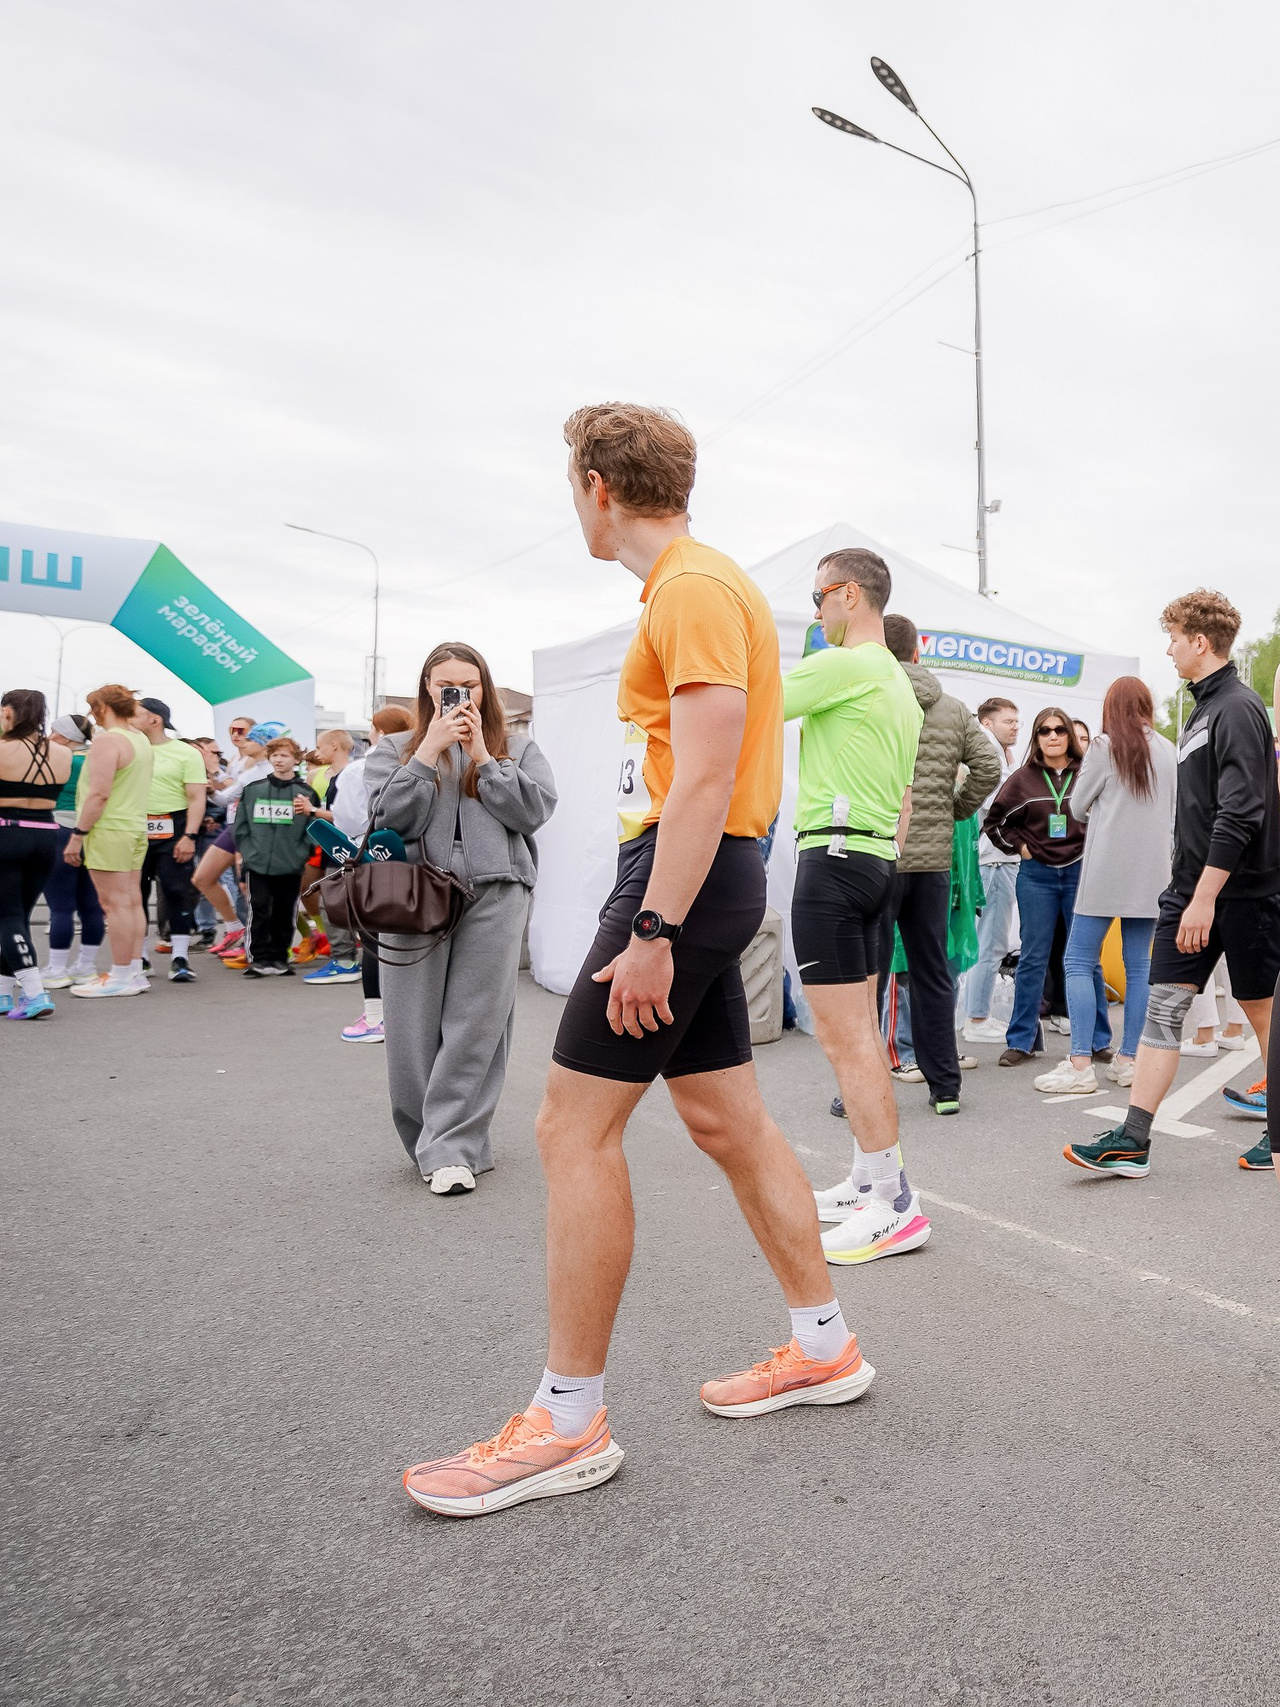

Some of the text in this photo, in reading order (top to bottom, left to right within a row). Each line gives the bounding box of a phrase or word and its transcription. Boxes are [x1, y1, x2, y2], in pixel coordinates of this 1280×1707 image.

[157, 605, 242, 674] марафон
[172, 595, 259, 664] зелёный
[984, 665, 1024, 679] АВТОНОМНОГО
[1024, 672, 1044, 682] ОКРУГА
[260, 807, 290, 816] 1164
